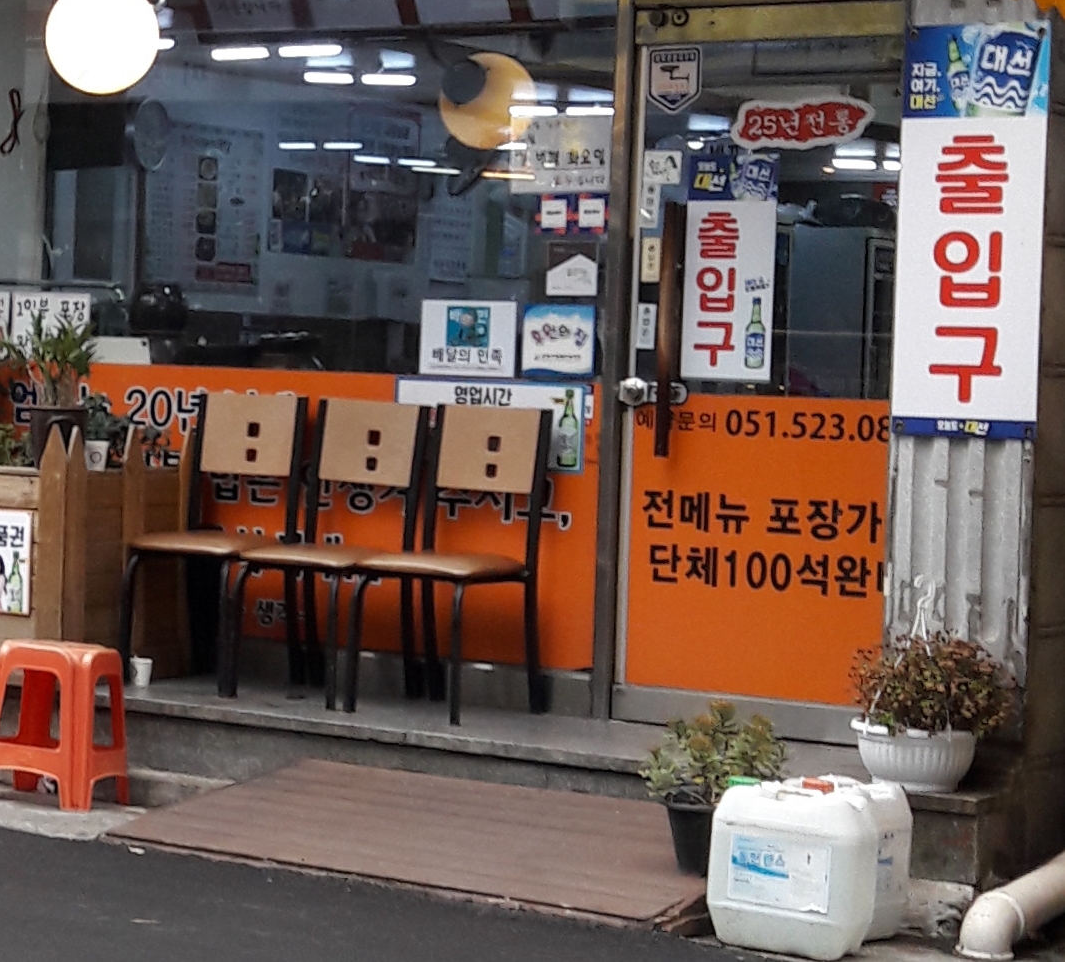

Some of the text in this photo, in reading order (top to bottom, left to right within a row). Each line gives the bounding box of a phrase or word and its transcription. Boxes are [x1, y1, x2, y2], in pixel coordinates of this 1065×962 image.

[980, 44, 1034, 77] 대선
[693, 211, 740, 367] 출입구
[929, 134, 1010, 404] 출입구
[454, 385, 512, 407] 영업시간
[636, 409, 716, 433] 예문의
[642, 490, 882, 544] 전메뉴 포장가
[649, 544, 885, 598] 단체100석완
